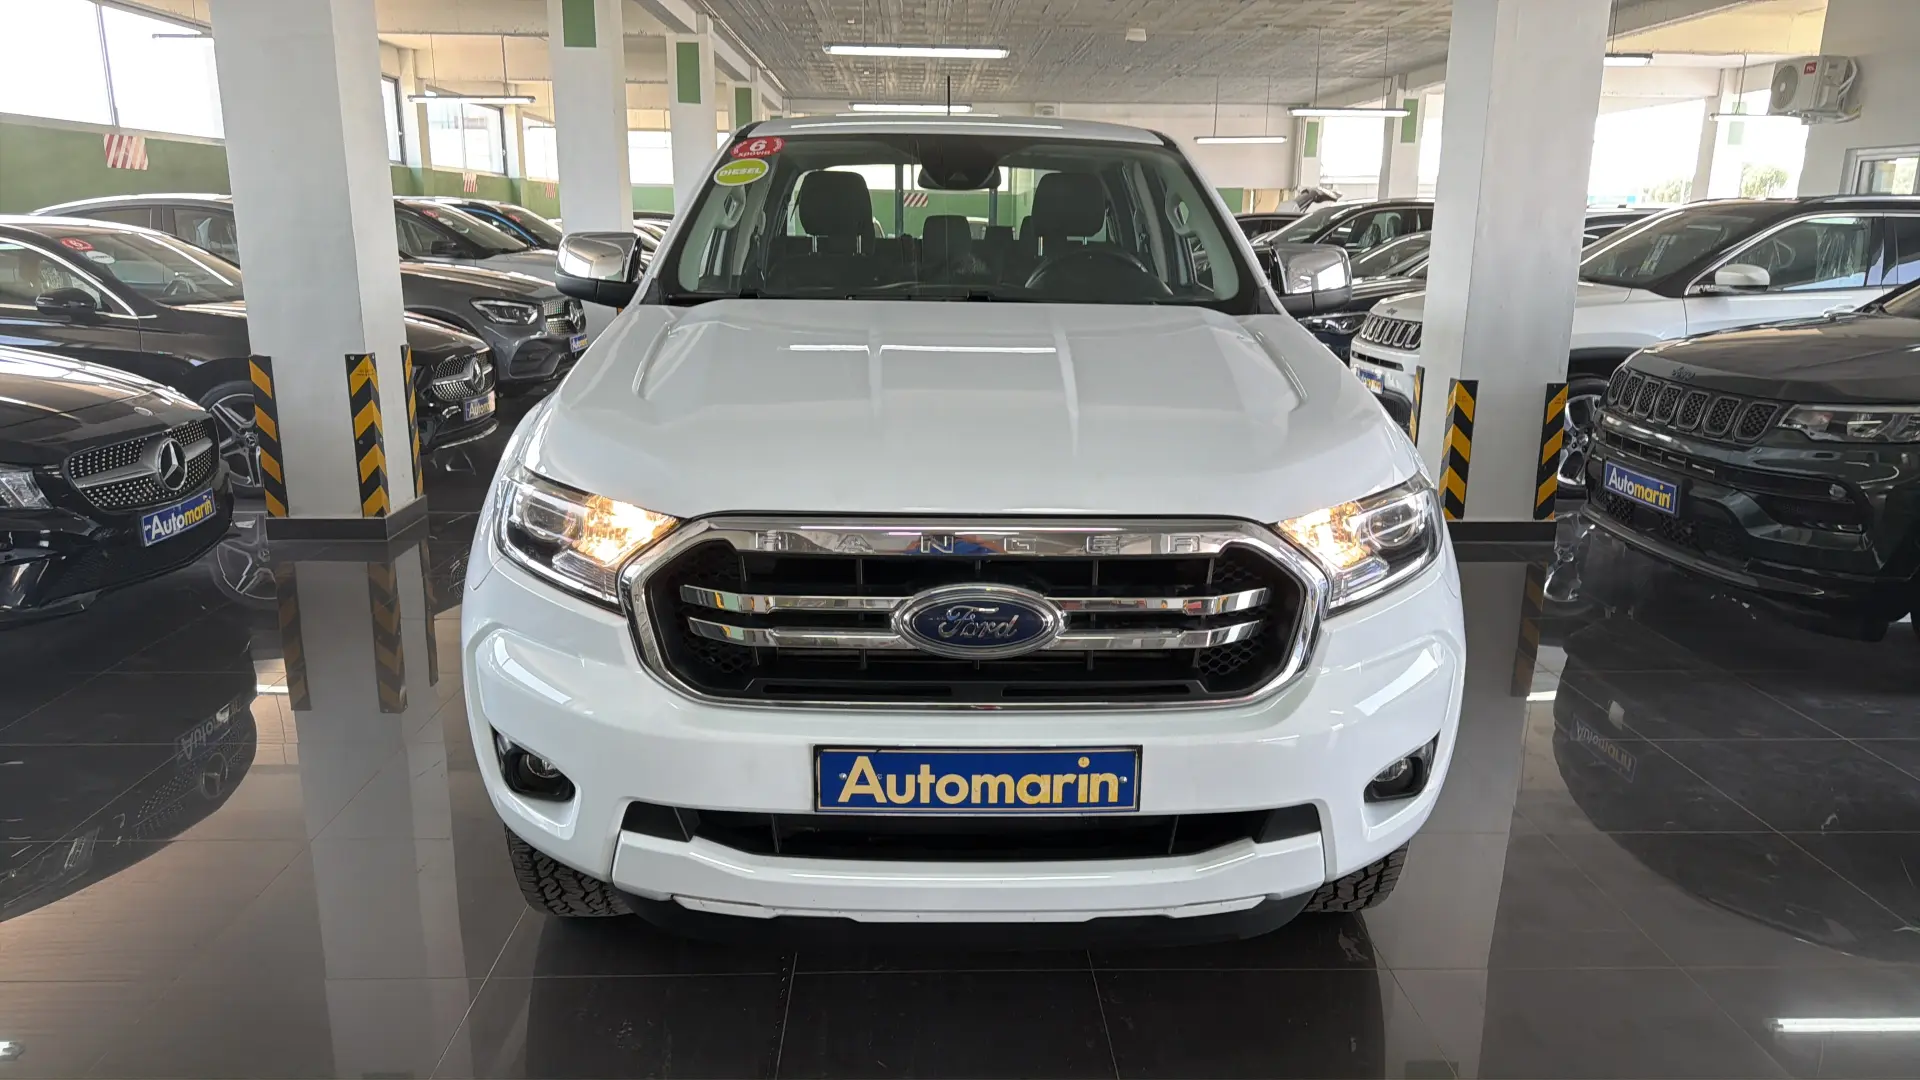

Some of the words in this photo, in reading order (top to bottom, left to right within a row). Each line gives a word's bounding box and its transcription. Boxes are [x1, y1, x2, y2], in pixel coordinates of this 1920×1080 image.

[749, 139, 768, 152] 6
[719, 167, 761, 177] DIESEL
[1608, 466, 1672, 509] Automarin
[151, 495, 213, 540] Automarin
[754, 532, 1201, 554] RANGER
[938, 605, 1019, 638] Ford
[838, 755, 1119, 804] Automarin
